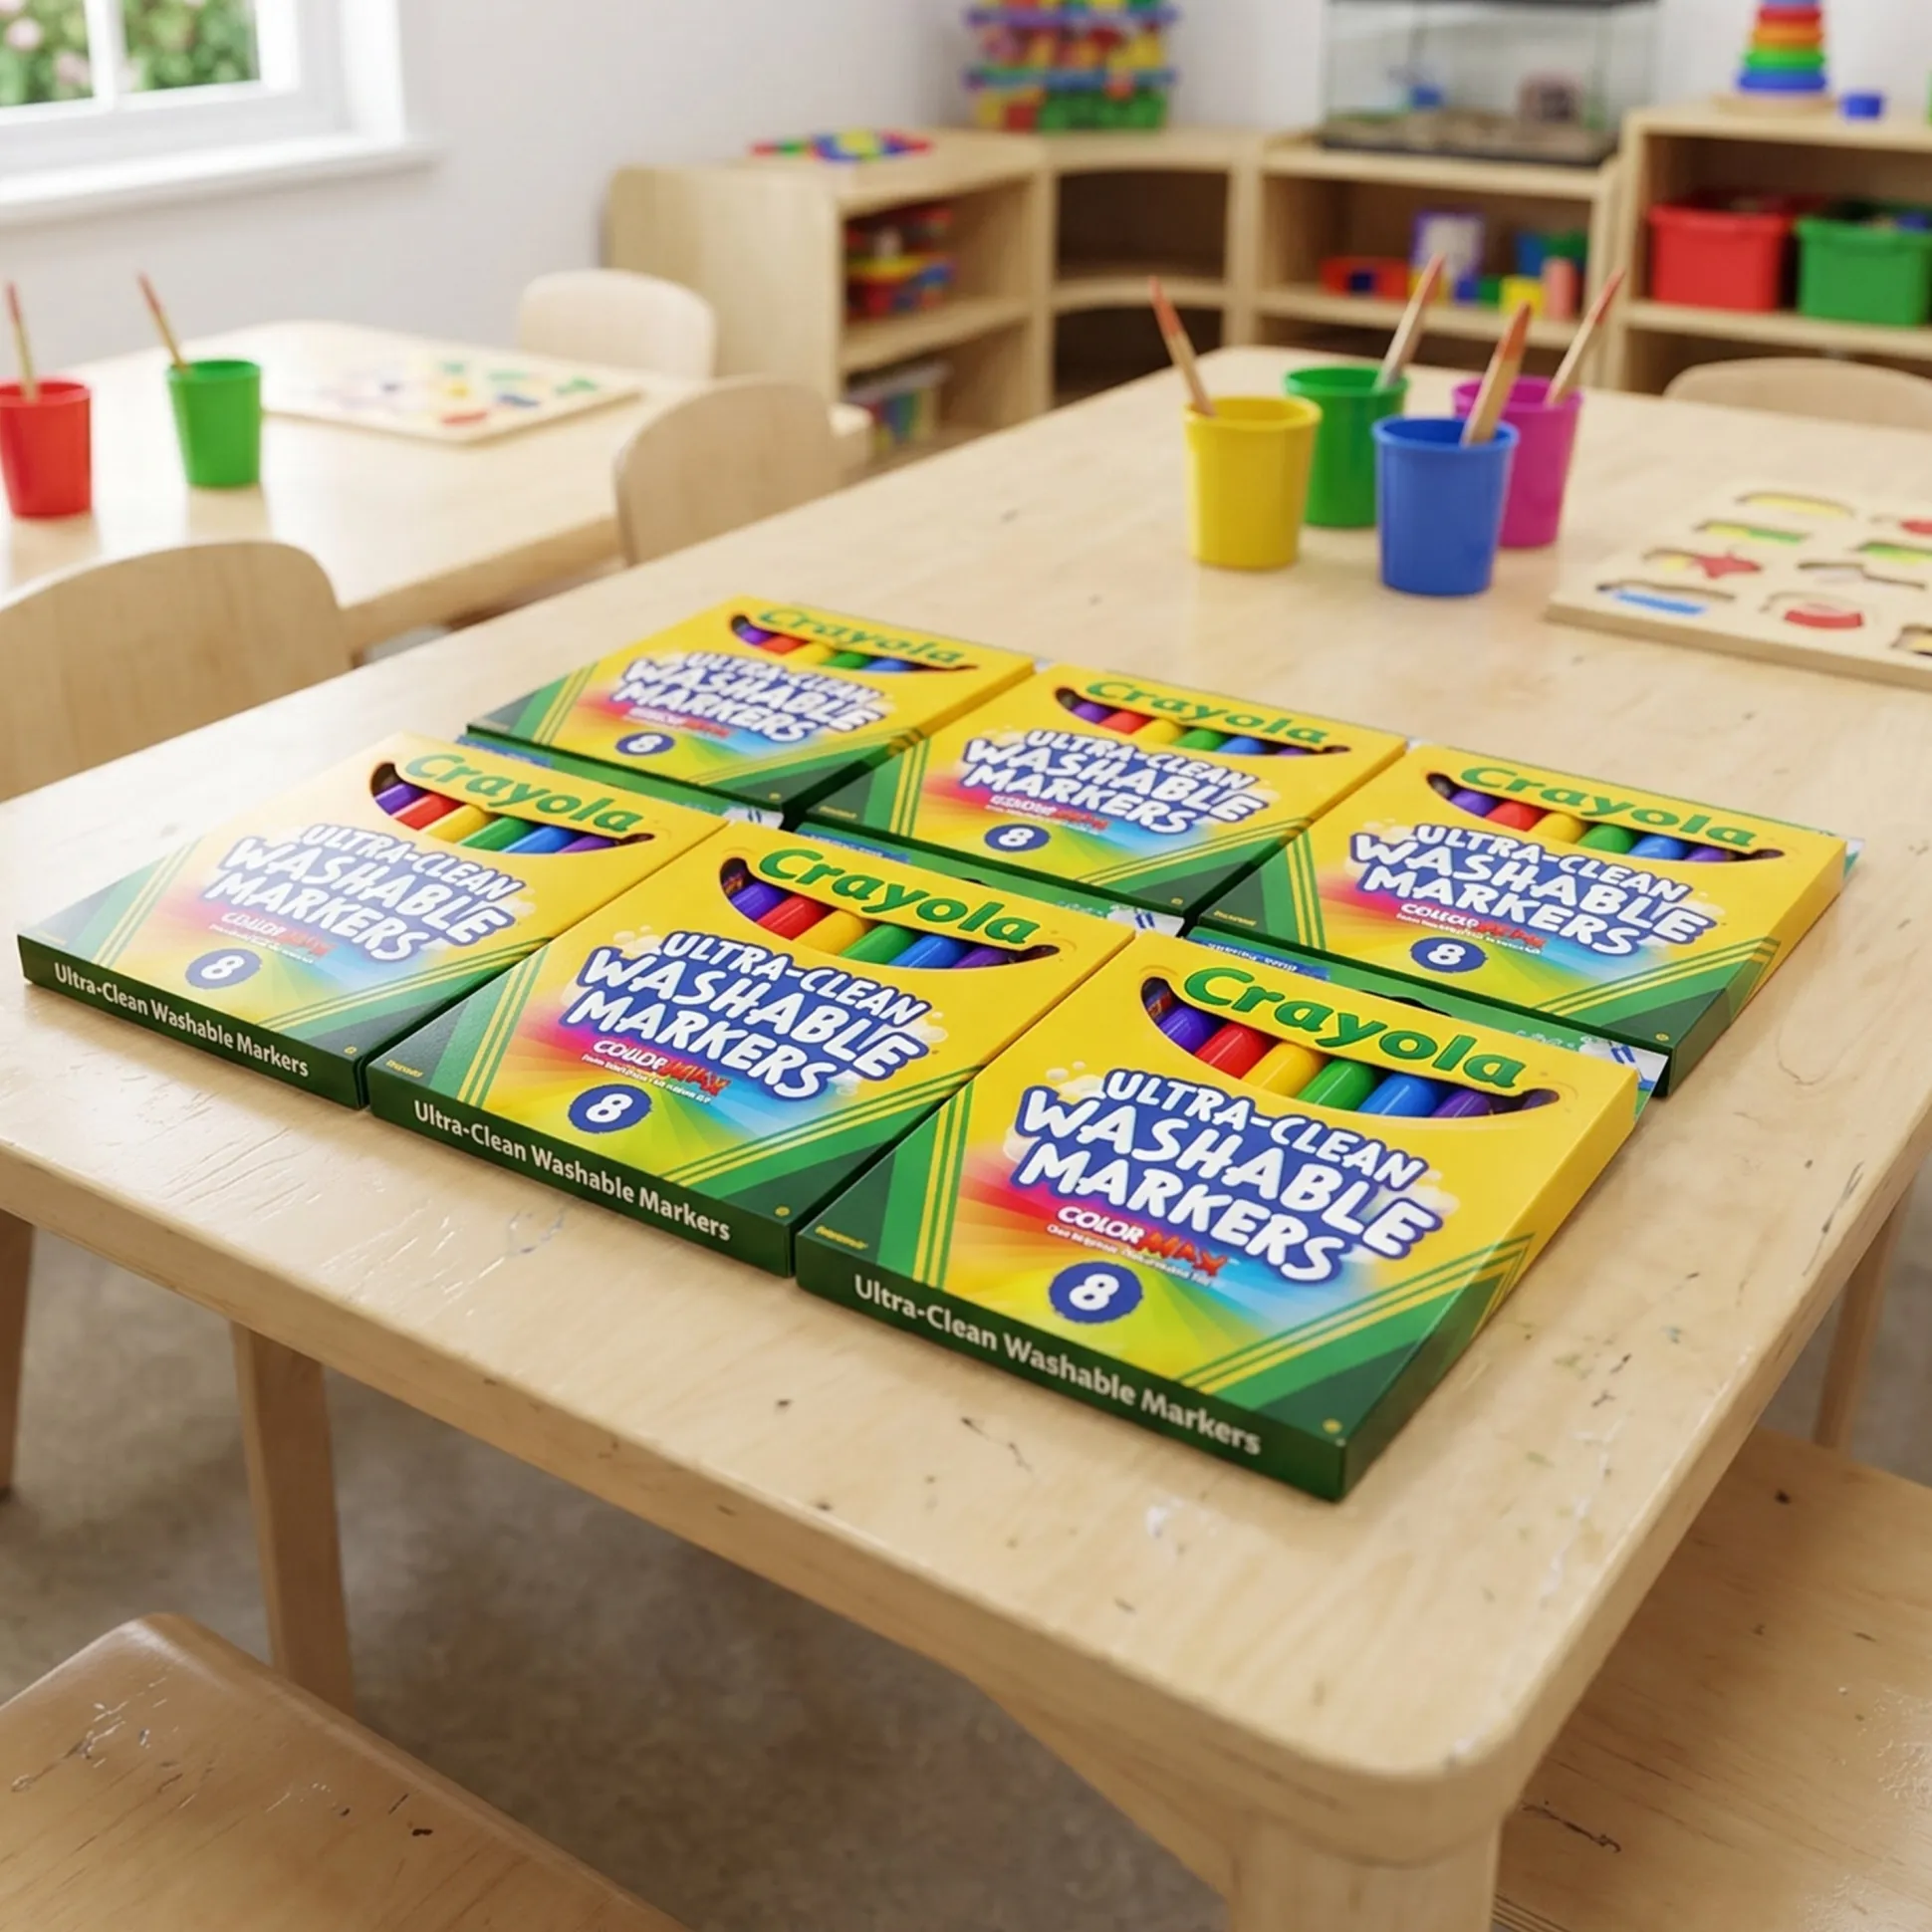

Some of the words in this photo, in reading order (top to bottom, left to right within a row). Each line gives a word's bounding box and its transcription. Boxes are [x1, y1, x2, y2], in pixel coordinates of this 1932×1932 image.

[758, 609, 965, 663] Crayola
[612, 680, 815, 742] MARKERS
[622, 658, 884, 731] WASHABLE
[1086, 681, 1329, 744] Crayola
[627, 735, 662, 752] 8
[967, 739, 1267, 822] WASHABLE
[1026, 730, 1259, 789] ULTRA-CLEAN
[405, 754, 643, 832] Crayola
[964, 765, 1194, 834] MARKERS
[1461, 766, 1757, 848] Crayola
[302, 825, 522, 900] ULTRA-CLEAN
[998, 828, 1035, 846] 8
[1416, 825, 1691, 901] ULTRA-CLEAN
[204, 872, 431, 961] MARKERS
[223, 838, 510, 944] WASHABLE
[759, 848, 1041, 944] Crayola
[1354, 835, 1709, 941] WASHABLE
[1362, 866, 1642, 956] MARKERS
[201, 955, 245, 979] 8
[662, 932, 930, 1024] ULTRA-CLEAN
[1427, 943, 1466, 965] 8
[54, 962, 149, 1016] Ultra-Clean
[150, 1000, 234, 1049] Washable
[237, 1033, 310, 1078] Markers
[567, 991, 838, 1097] MARKERS
[584, 949, 920, 1078] WASHABLE
[1184, 967, 1527, 1088] Crayola
[586, 1092, 633, 1122] 8
[1104, 1072, 1428, 1190] ULTRA-CLEAN
[414, 1099, 527, 1162] Ultra-Clean
[531, 1144, 634, 1203] Washable
[639, 1187, 731, 1242] Markers
[1023, 1089, 1436, 1256] WASHABLE
[1018, 1143, 1344, 1282] MARKERS
[1058, 1206, 1145, 1244] COLOR
[1069, 1274, 1119, 1311] 8
[853, 1275, 997, 1351] Ultra-Clean
[1003, 1333, 1135, 1405] Washable
[1141, 1388, 1262, 1456] Markers
